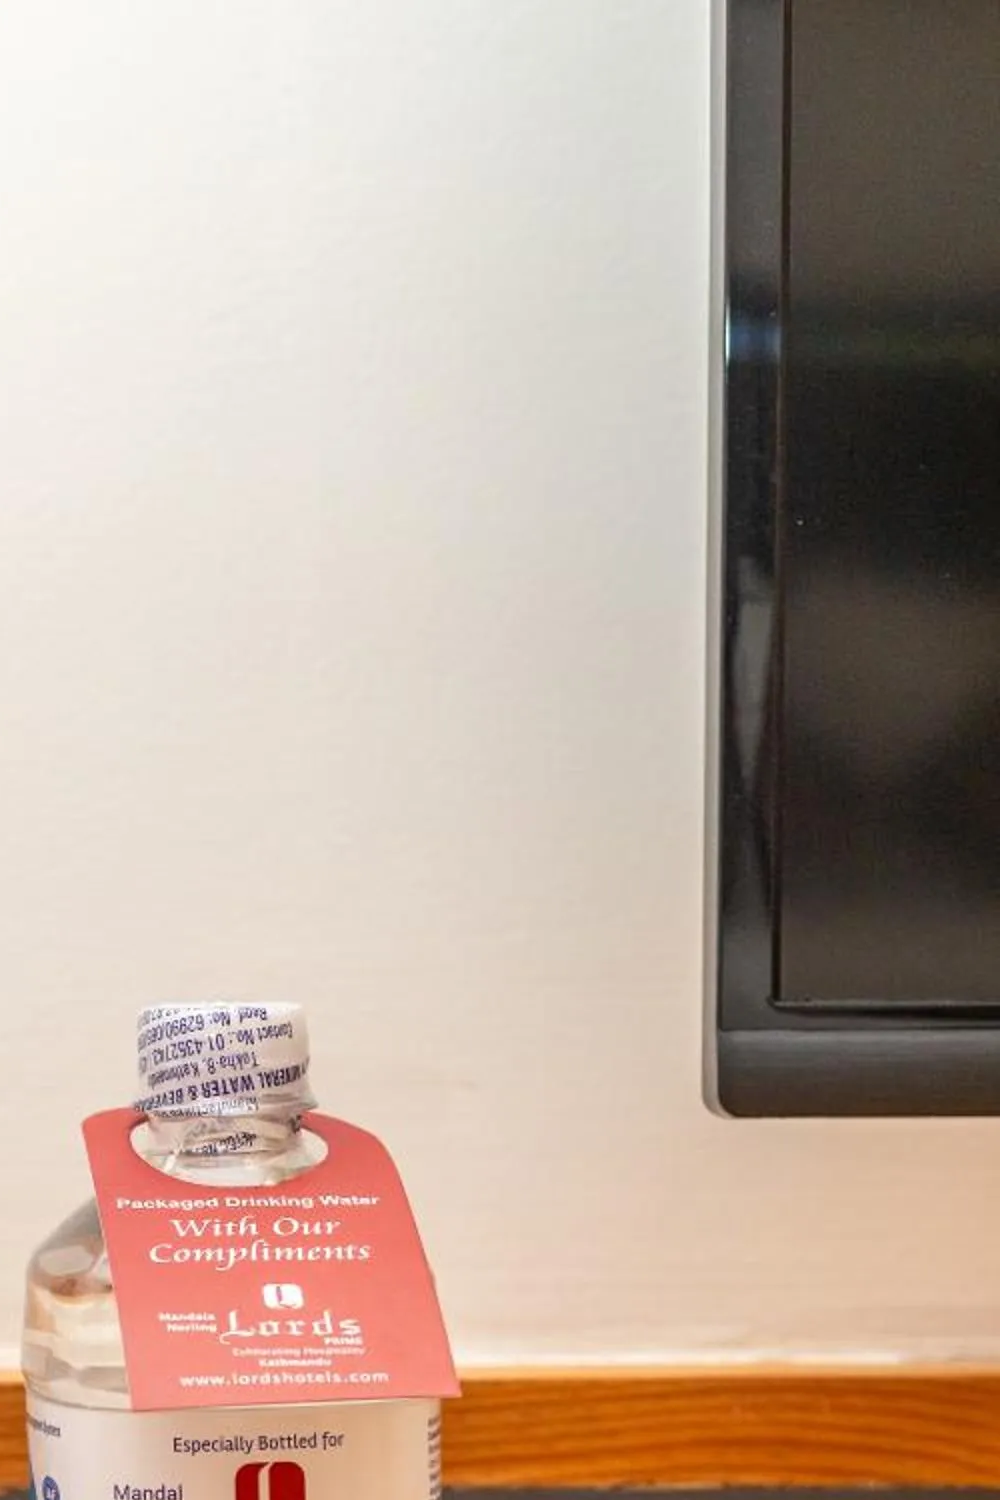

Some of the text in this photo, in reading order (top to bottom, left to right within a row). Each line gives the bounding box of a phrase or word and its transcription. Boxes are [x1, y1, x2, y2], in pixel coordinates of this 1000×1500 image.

[187, 1083, 200, 1101] &
[202, 1074, 256, 1098] WATER
[116, 1194, 380, 1211] Packaged Drinking Water
[169, 1214, 341, 1238] With Our
[149, 1238, 372, 1272] Compliments
[219, 1309, 363, 1345] Lords
[179, 1371, 390, 1388] www.lordshotels.com
[173, 1431, 345, 1456] Especially Bottled for
